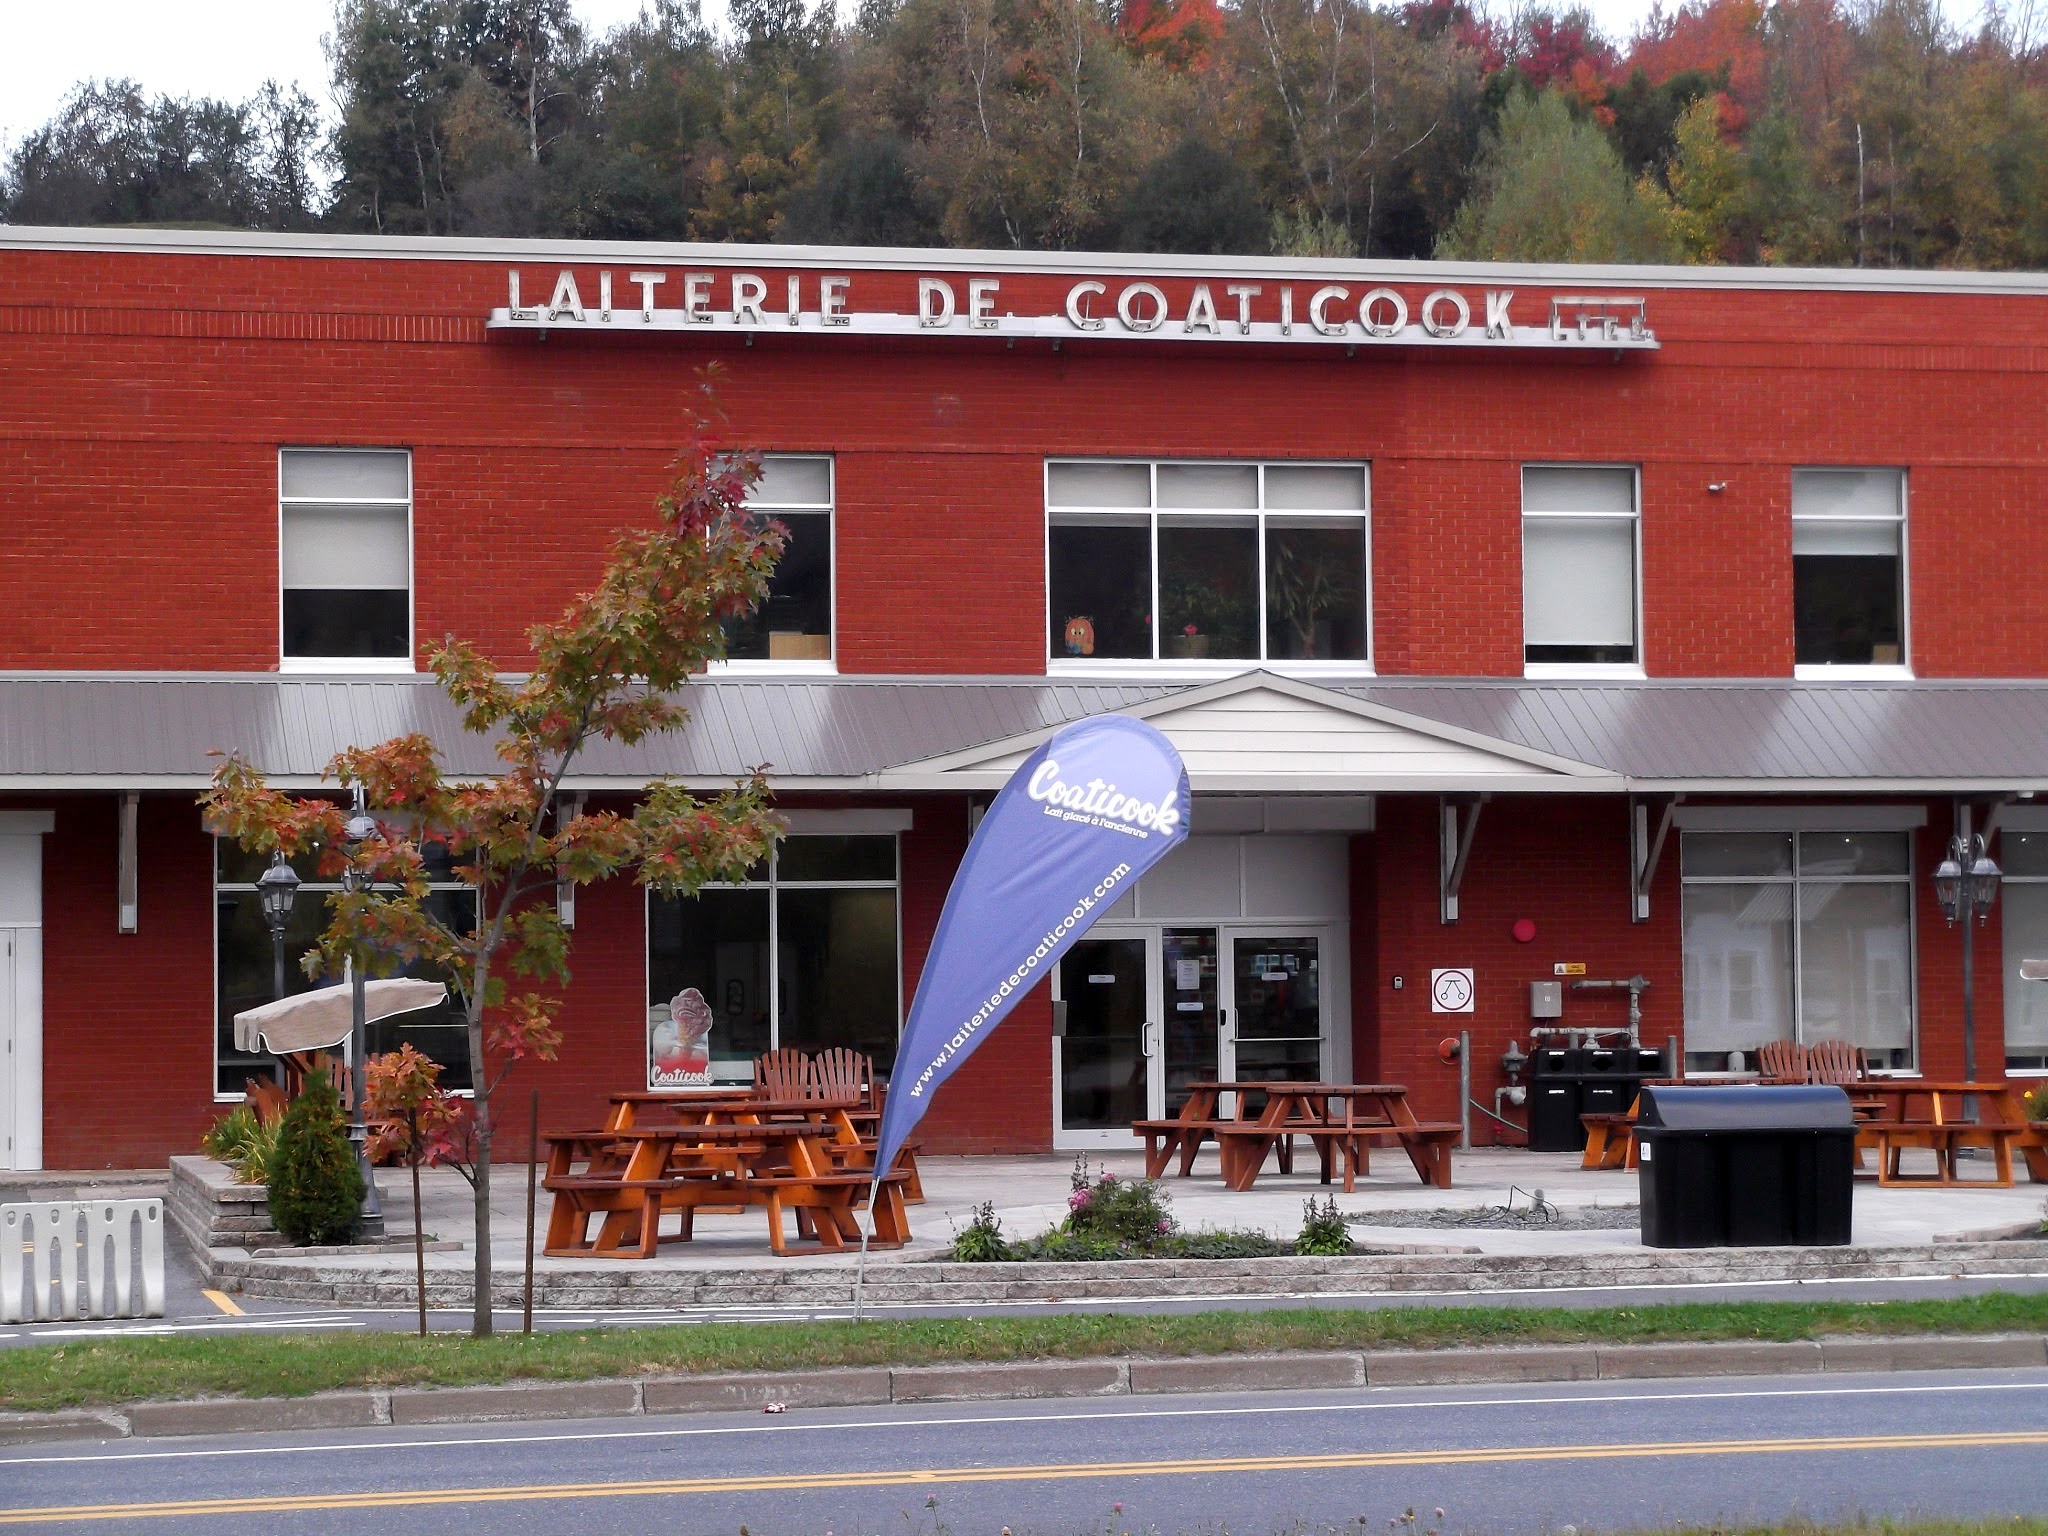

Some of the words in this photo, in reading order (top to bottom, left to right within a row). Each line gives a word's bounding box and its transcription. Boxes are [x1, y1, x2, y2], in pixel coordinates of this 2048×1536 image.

[508, 269, 851, 328] LAITERIE
[918, 277, 1000, 330] DE
[1065, 281, 1515, 340] COATICOOK
[1028, 759, 1181, 837] Coaticook
[1043, 805, 1063, 817] Lait
[1063, 811, 1091, 825] glacé
[1091, 815, 1099, 826] à
[1098, 818, 1149, 840] l'ancienne
[910, 862, 1132, 1098] www.laiteriedecoaticook.com
[652, 1065, 713, 1084] Coaticook
